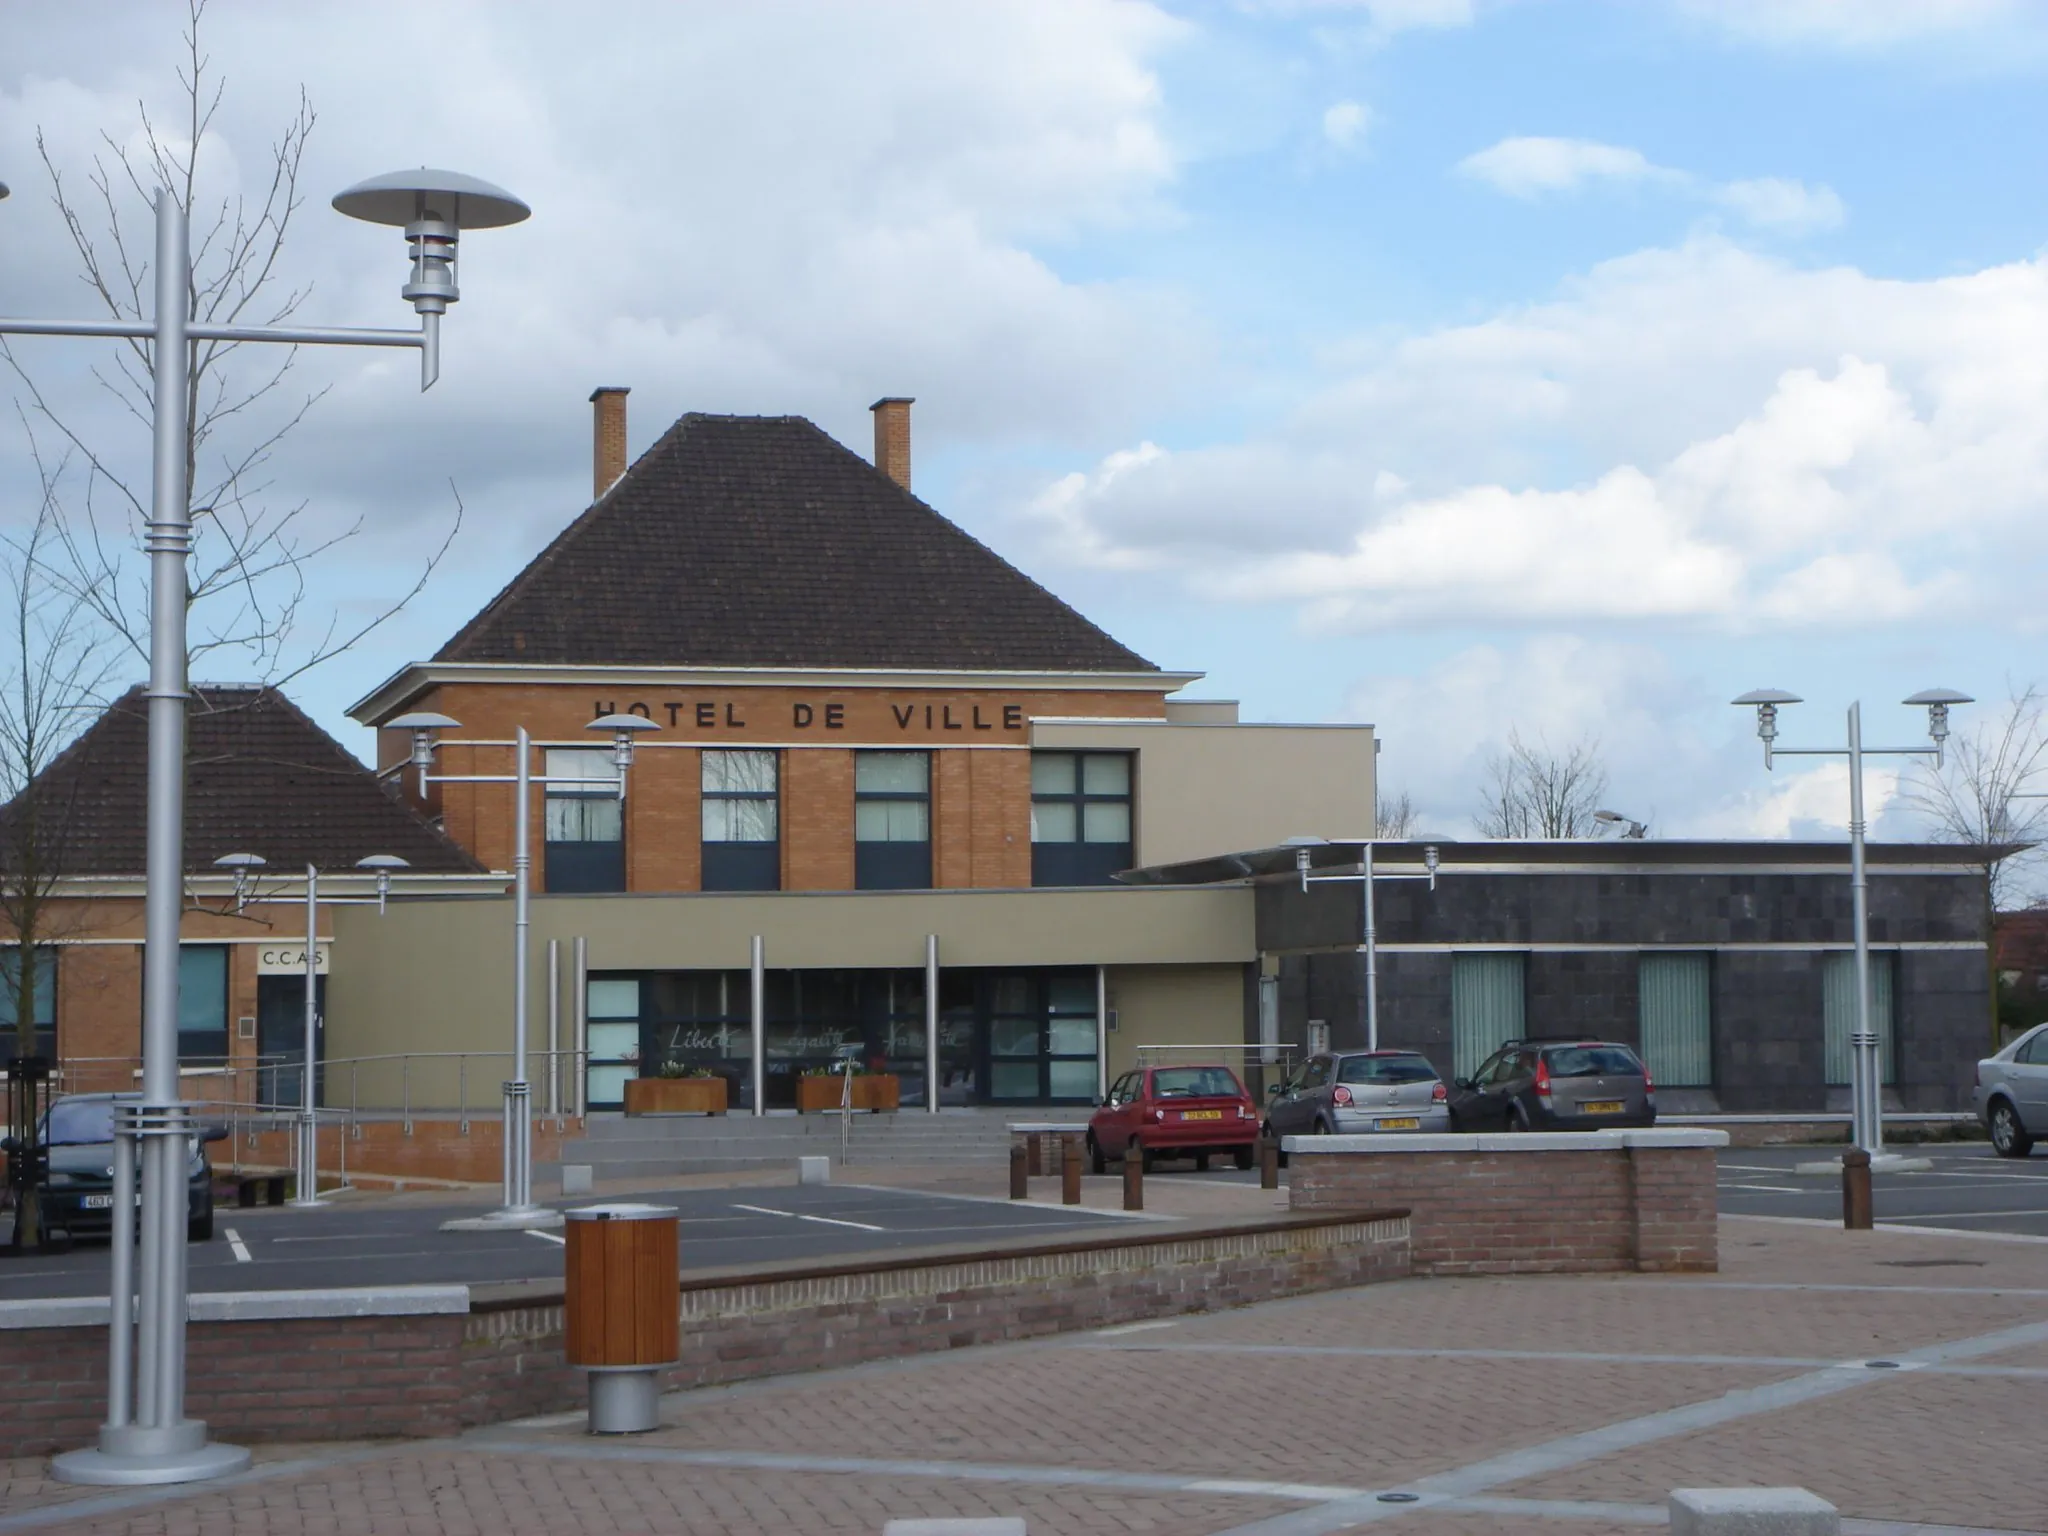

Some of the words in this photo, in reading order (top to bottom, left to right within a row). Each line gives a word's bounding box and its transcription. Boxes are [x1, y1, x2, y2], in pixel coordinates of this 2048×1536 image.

[594, 702, 745, 728] HOTEL
[793, 703, 844, 729] DE
[892, 704, 1022, 729] VILLE
